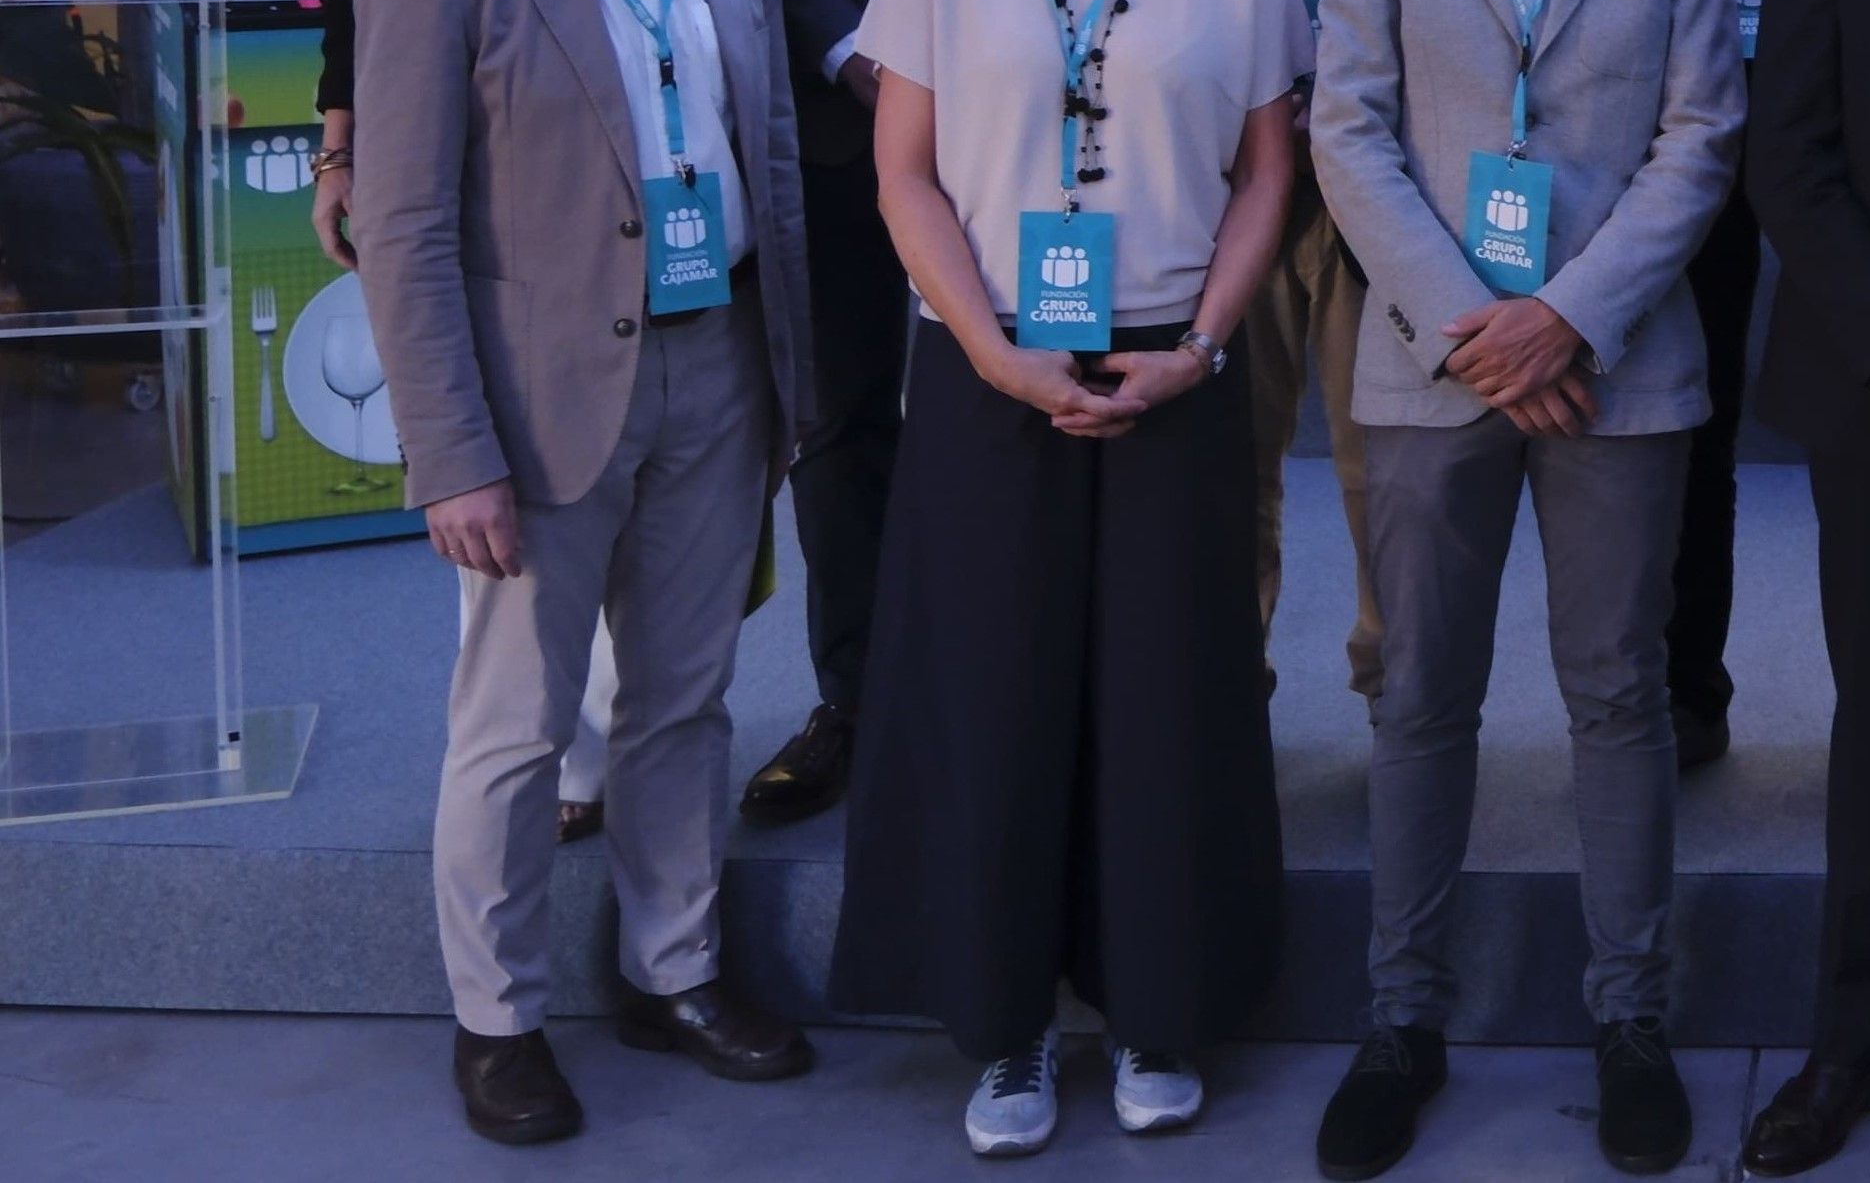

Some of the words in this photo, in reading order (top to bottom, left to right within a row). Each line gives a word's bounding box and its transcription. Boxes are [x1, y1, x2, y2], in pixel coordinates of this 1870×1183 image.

[1483, 238, 1526, 257] GRUPO
[667, 258, 710, 274] GRUPO
[1474, 247, 1534, 270] CAJAMAR
[660, 267, 719, 286] CAJAMAR
[1038, 299, 1089, 312] GRUPO
[1029, 310, 1098, 325] CAJAMAR
